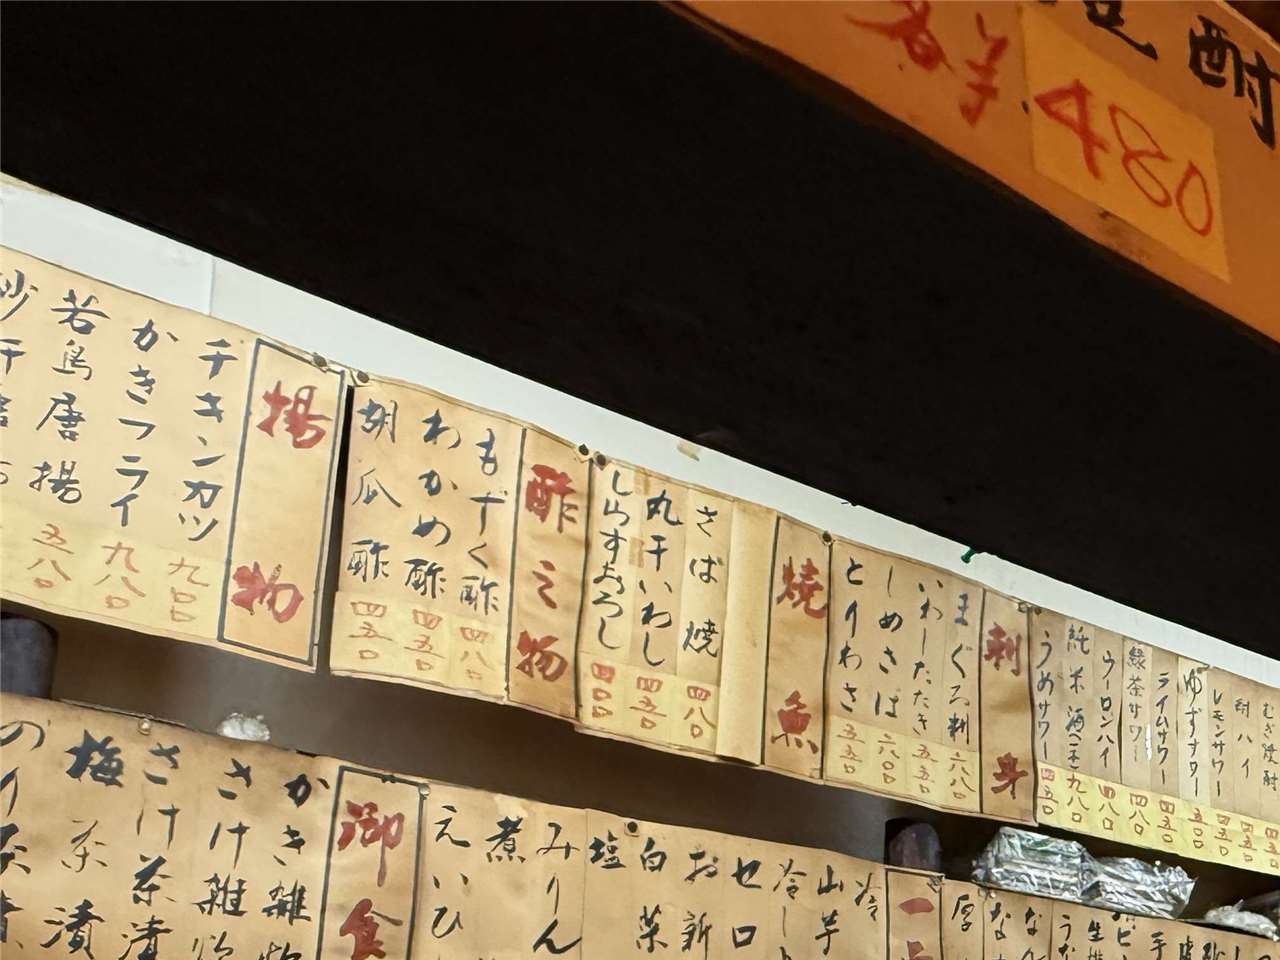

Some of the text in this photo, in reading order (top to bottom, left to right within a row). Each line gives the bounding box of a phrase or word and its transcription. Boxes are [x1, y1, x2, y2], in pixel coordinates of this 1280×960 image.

[1035, 80, 1213, 235] 480
[110, 318, 178, 527] かきフライ
[179, 338, 238, 541] チキンカツ
[347, 398, 402, 582] 胡瓜酢
[231, 380, 333, 625] 揚物
[404, 408, 461, 599] わかめ酢
[460, 428, 508, 615] もずく酢
[592, 470, 633, 650] しらすおろし
[638, 489, 684, 666] 丸干いわし
[683, 505, 723, 657] さば焼
[771, 556, 828, 754] 焼魚
[839, 556, 863, 713] とりわさ
[875, 565, 903, 719] しめさば
[912, 579, 943, 736] いわしたたき
[948, 593, 972, 744] まぐろ刺
[984, 622, 1029, 799] 刺身
[1037, 631, 1053, 760] うめサワー
[1097, 650, 1115, 768] ウーロンハイ
[1127, 646, 1146, 762] 緑茶サワー
[1154, 672, 1169, 784] ライムサワー
[1183, 669, 1202, 797] ゆずサワー
[1212, 689, 1226, 796] レモンサワー
[1235, 697, 1253, 779] 酎ハイ
